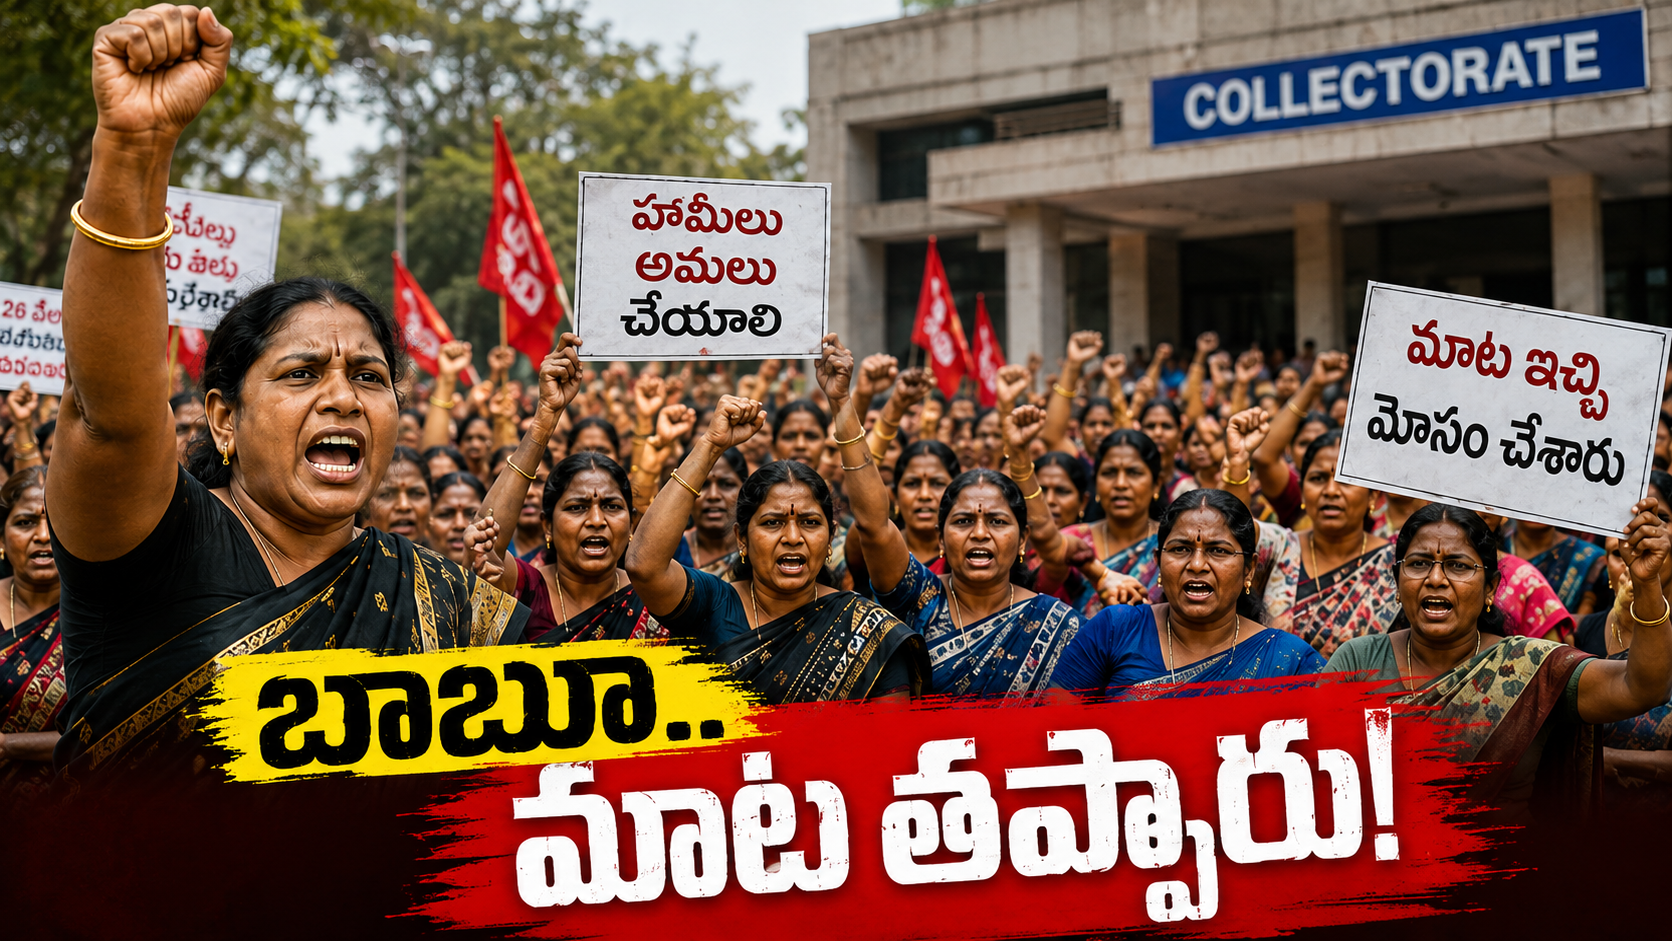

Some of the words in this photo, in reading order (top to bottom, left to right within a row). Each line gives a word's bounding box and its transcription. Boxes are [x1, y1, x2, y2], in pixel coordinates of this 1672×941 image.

[1183, 29, 1602, 131] COLLECTORATE
[631, 192, 783, 236] హామీలు
[635, 246, 777, 286] అమలు
[2, 300, 26, 319] 26
[620, 290, 782, 337] చేయాలి
[1407, 319, 1512, 379] మాట
[1525, 349, 1609, 422] ఇచ్చి
[1367, 393, 1489, 459] మోసం
[1499, 413, 1625, 486] చేశారు
